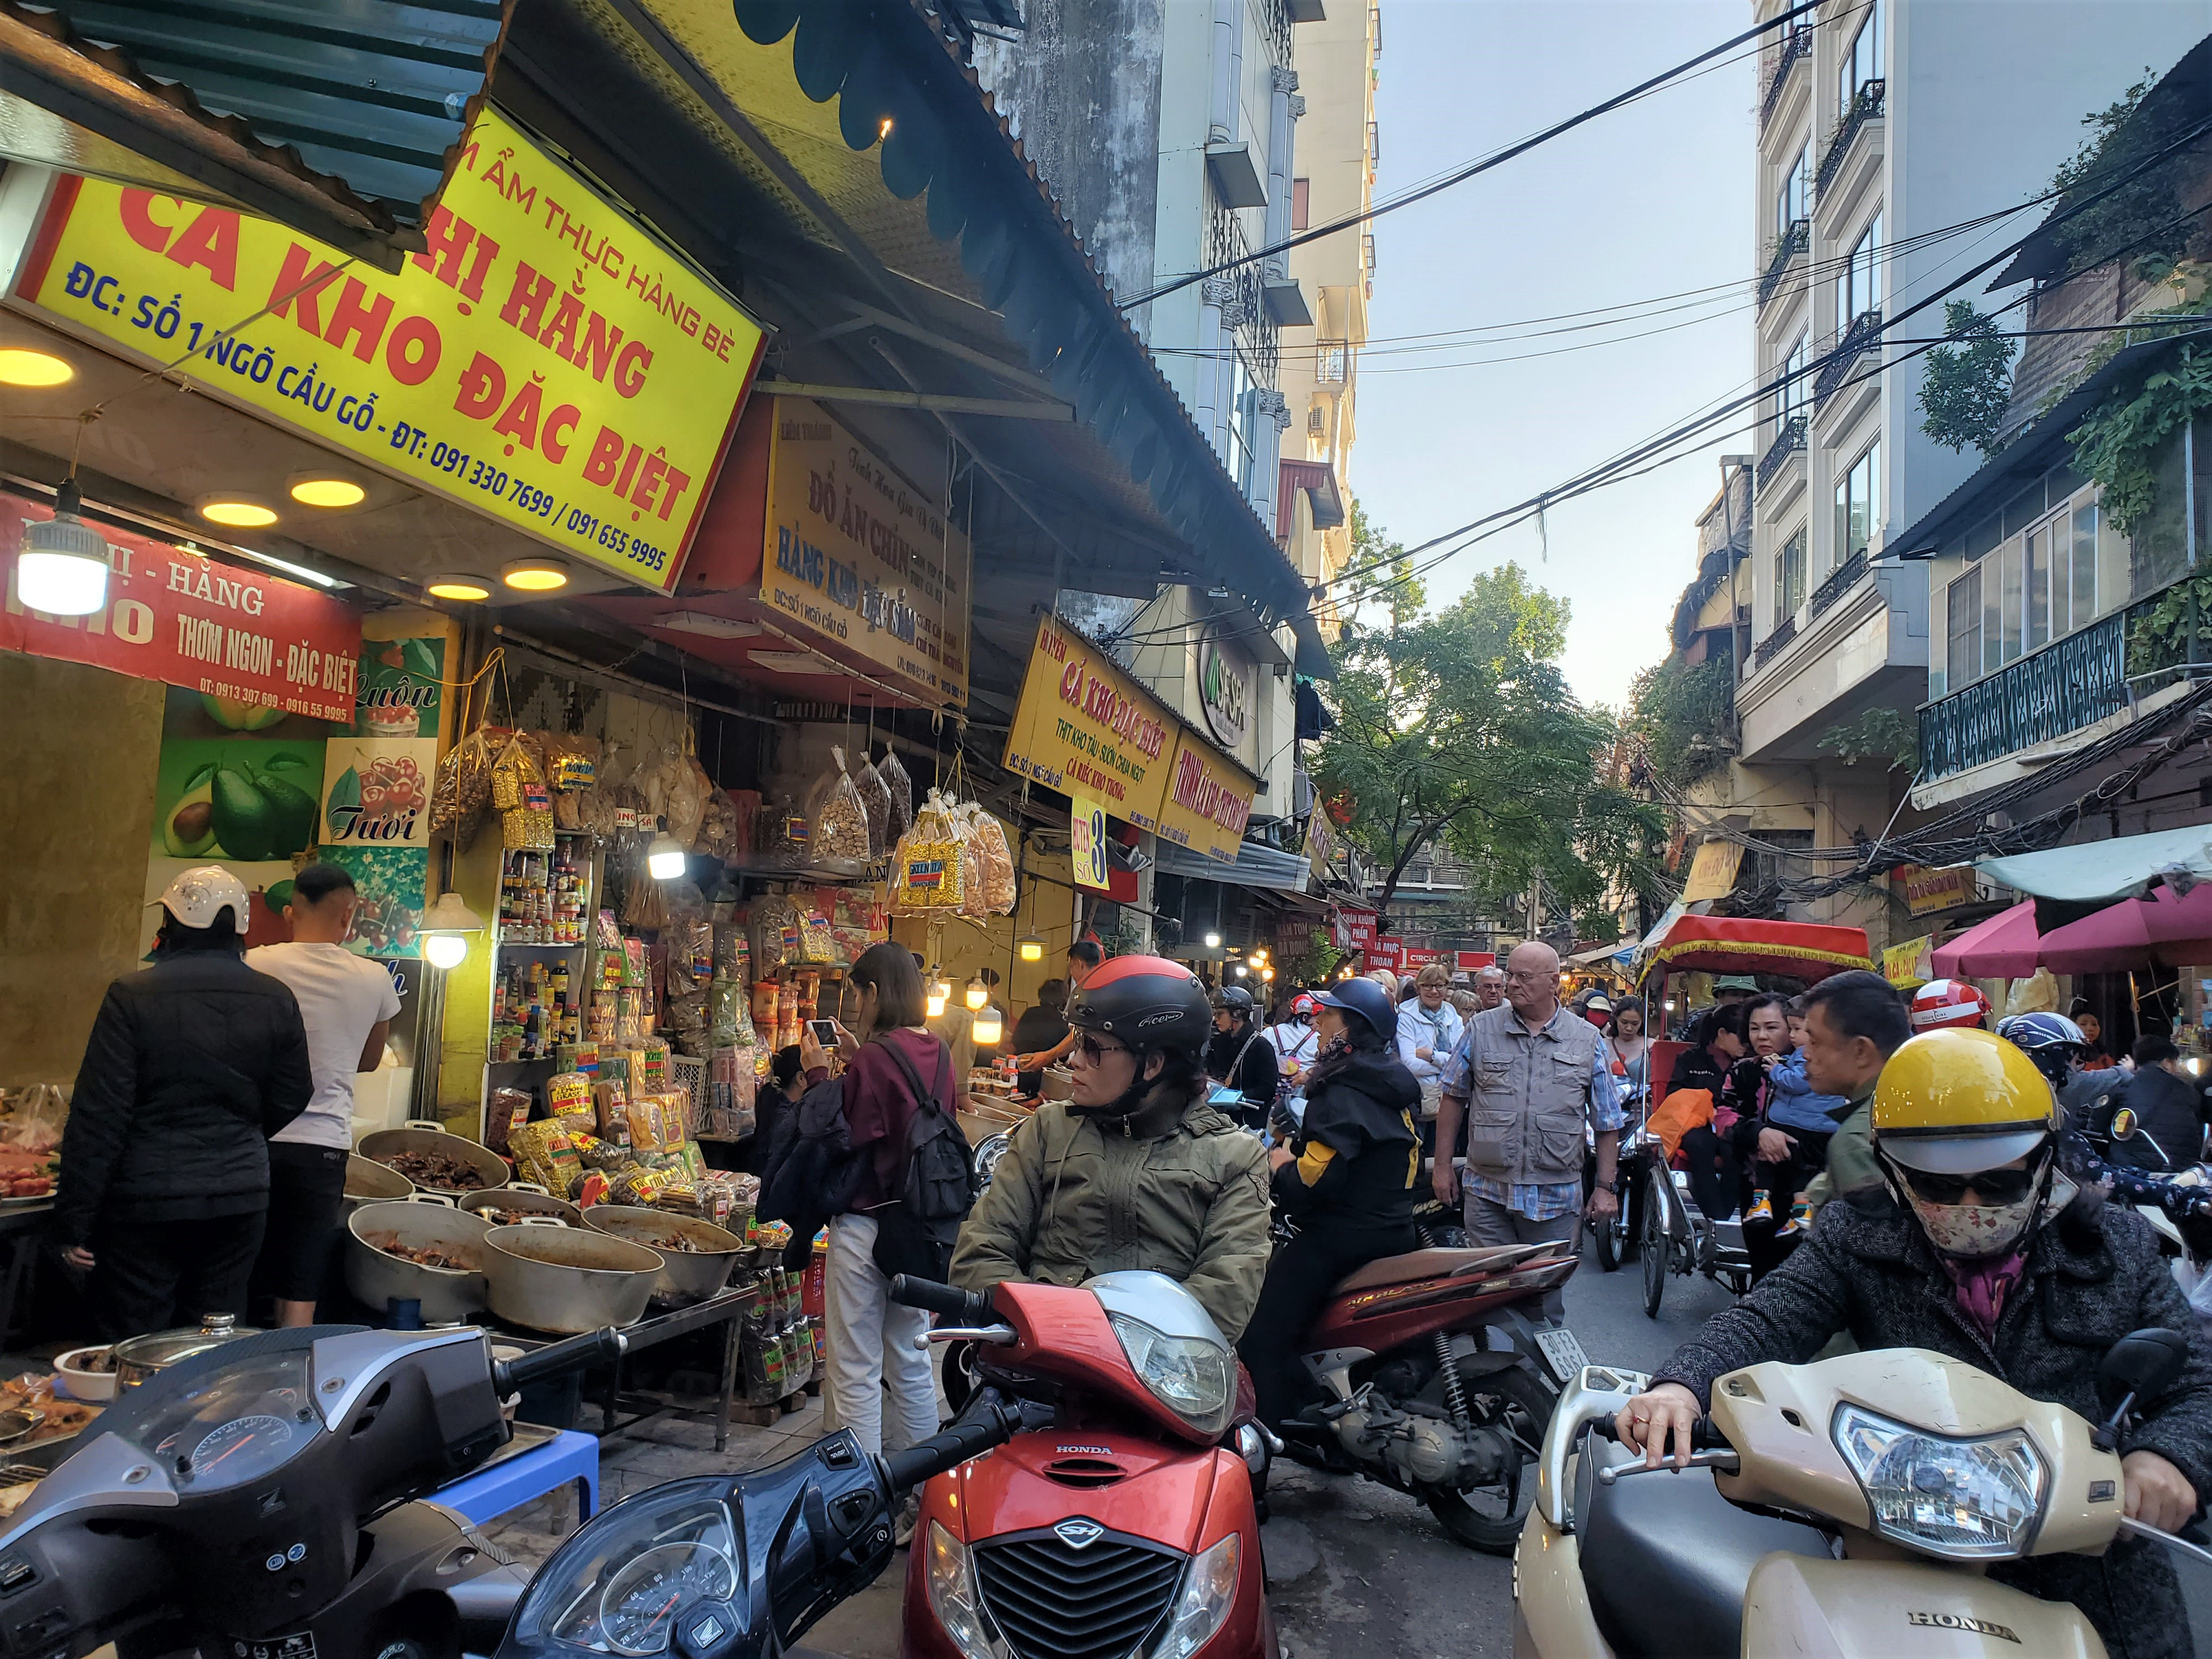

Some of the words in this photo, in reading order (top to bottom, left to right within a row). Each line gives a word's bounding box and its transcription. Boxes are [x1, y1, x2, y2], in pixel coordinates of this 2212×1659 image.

[481, 146, 537, 214] ẨM
[544, 196, 624, 279] THỰC
[626, 265, 701, 337] HÀNG
[702, 323, 735, 363] BÈ
[412, 204, 500, 315] HỊ
[499, 263, 654, 398] HẰNG
[265, 241, 441, 385] KHO
[453, 351, 582, 464] ĐẶC
[582, 425, 691, 522] BIỆT
[65, 261, 126, 316] ĐC:
[131, 294, 182, 339] SỐ
[187, 322, 204, 352] 1
[205, 330, 275, 383] NGÕ
[276, 362, 336, 411] CẦU
[336, 393, 380, 432] GỖ
[390, 421, 427, 459] ĐT:
[430, 442, 470, 477] 091
[469, 460, 508, 495] 330
[509, 479, 554, 517] 7699
[551, 503, 568, 526] /
[567, 508, 599, 540] 091
[598, 524, 627, 554] 655
[627, 537, 667, 571] 9995
[166, 557, 264, 617] HẰNG
[177, 613, 223, 664] THƠM
[225, 629, 273, 676] NGON
[286, 639, 319, 693] ĐẶC
[323, 650, 357, 702] BIỆT
[216, 682, 240, 699] 0913
[262, 693, 278, 708] 699
[286, 697, 308, 714] 0916
[311, 703, 323, 717] 55
[324, 706, 347, 721] 9995
[1060, 658, 1087, 706] CÁ
[1082, 676, 1118, 726] KHO
[1112, 695, 1142, 747] ĐẶC
[1137, 718, 1166, 765] BIỆT
[1229, 672, 1246, 732] SPA
[1056, 717, 1073, 744] THỊT
[1071, 729, 1087, 751] KHO
[1115, 754, 1130, 776] CHUA
[1129, 763, 1146, 786] NGỌT
[1066, 755, 1078, 778] CÁ
[1092, 770, 1106, 791] KHO
[330, 805, 417, 842] Tươi
[1091, 810, 1106, 884] 3
[909, 862, 929, 874] GREEN
[930, 861, 942, 874] TEA
[1076, 860, 1091, 881] SỐ
[1358, 913, 1376, 926] KHÔNG
[1352, 925, 1368, 940] PHẨM
[1383, 942, 1400, 956] MỰC
[1410, 954, 1438, 962] CIRCLE
[1370, 956, 1394, 968] THOAN
[556, 1086, 583, 1096] LEMON
[556, 1091, 582, 1101] GRASS
[1542, 1331, 1576, 1355] 30-F3
[1056, 1446, 1114, 1455] HONDA
[1059, 1525, 1098, 1536] SH
[630, 1592, 640, 1601] 60
[616, 1615, 625, 1624] 40
[1908, 1611, 2022, 1644] HONDA
[620, 1634, 630, 1645] 20
[702, 1629, 721, 1645] HONDA
